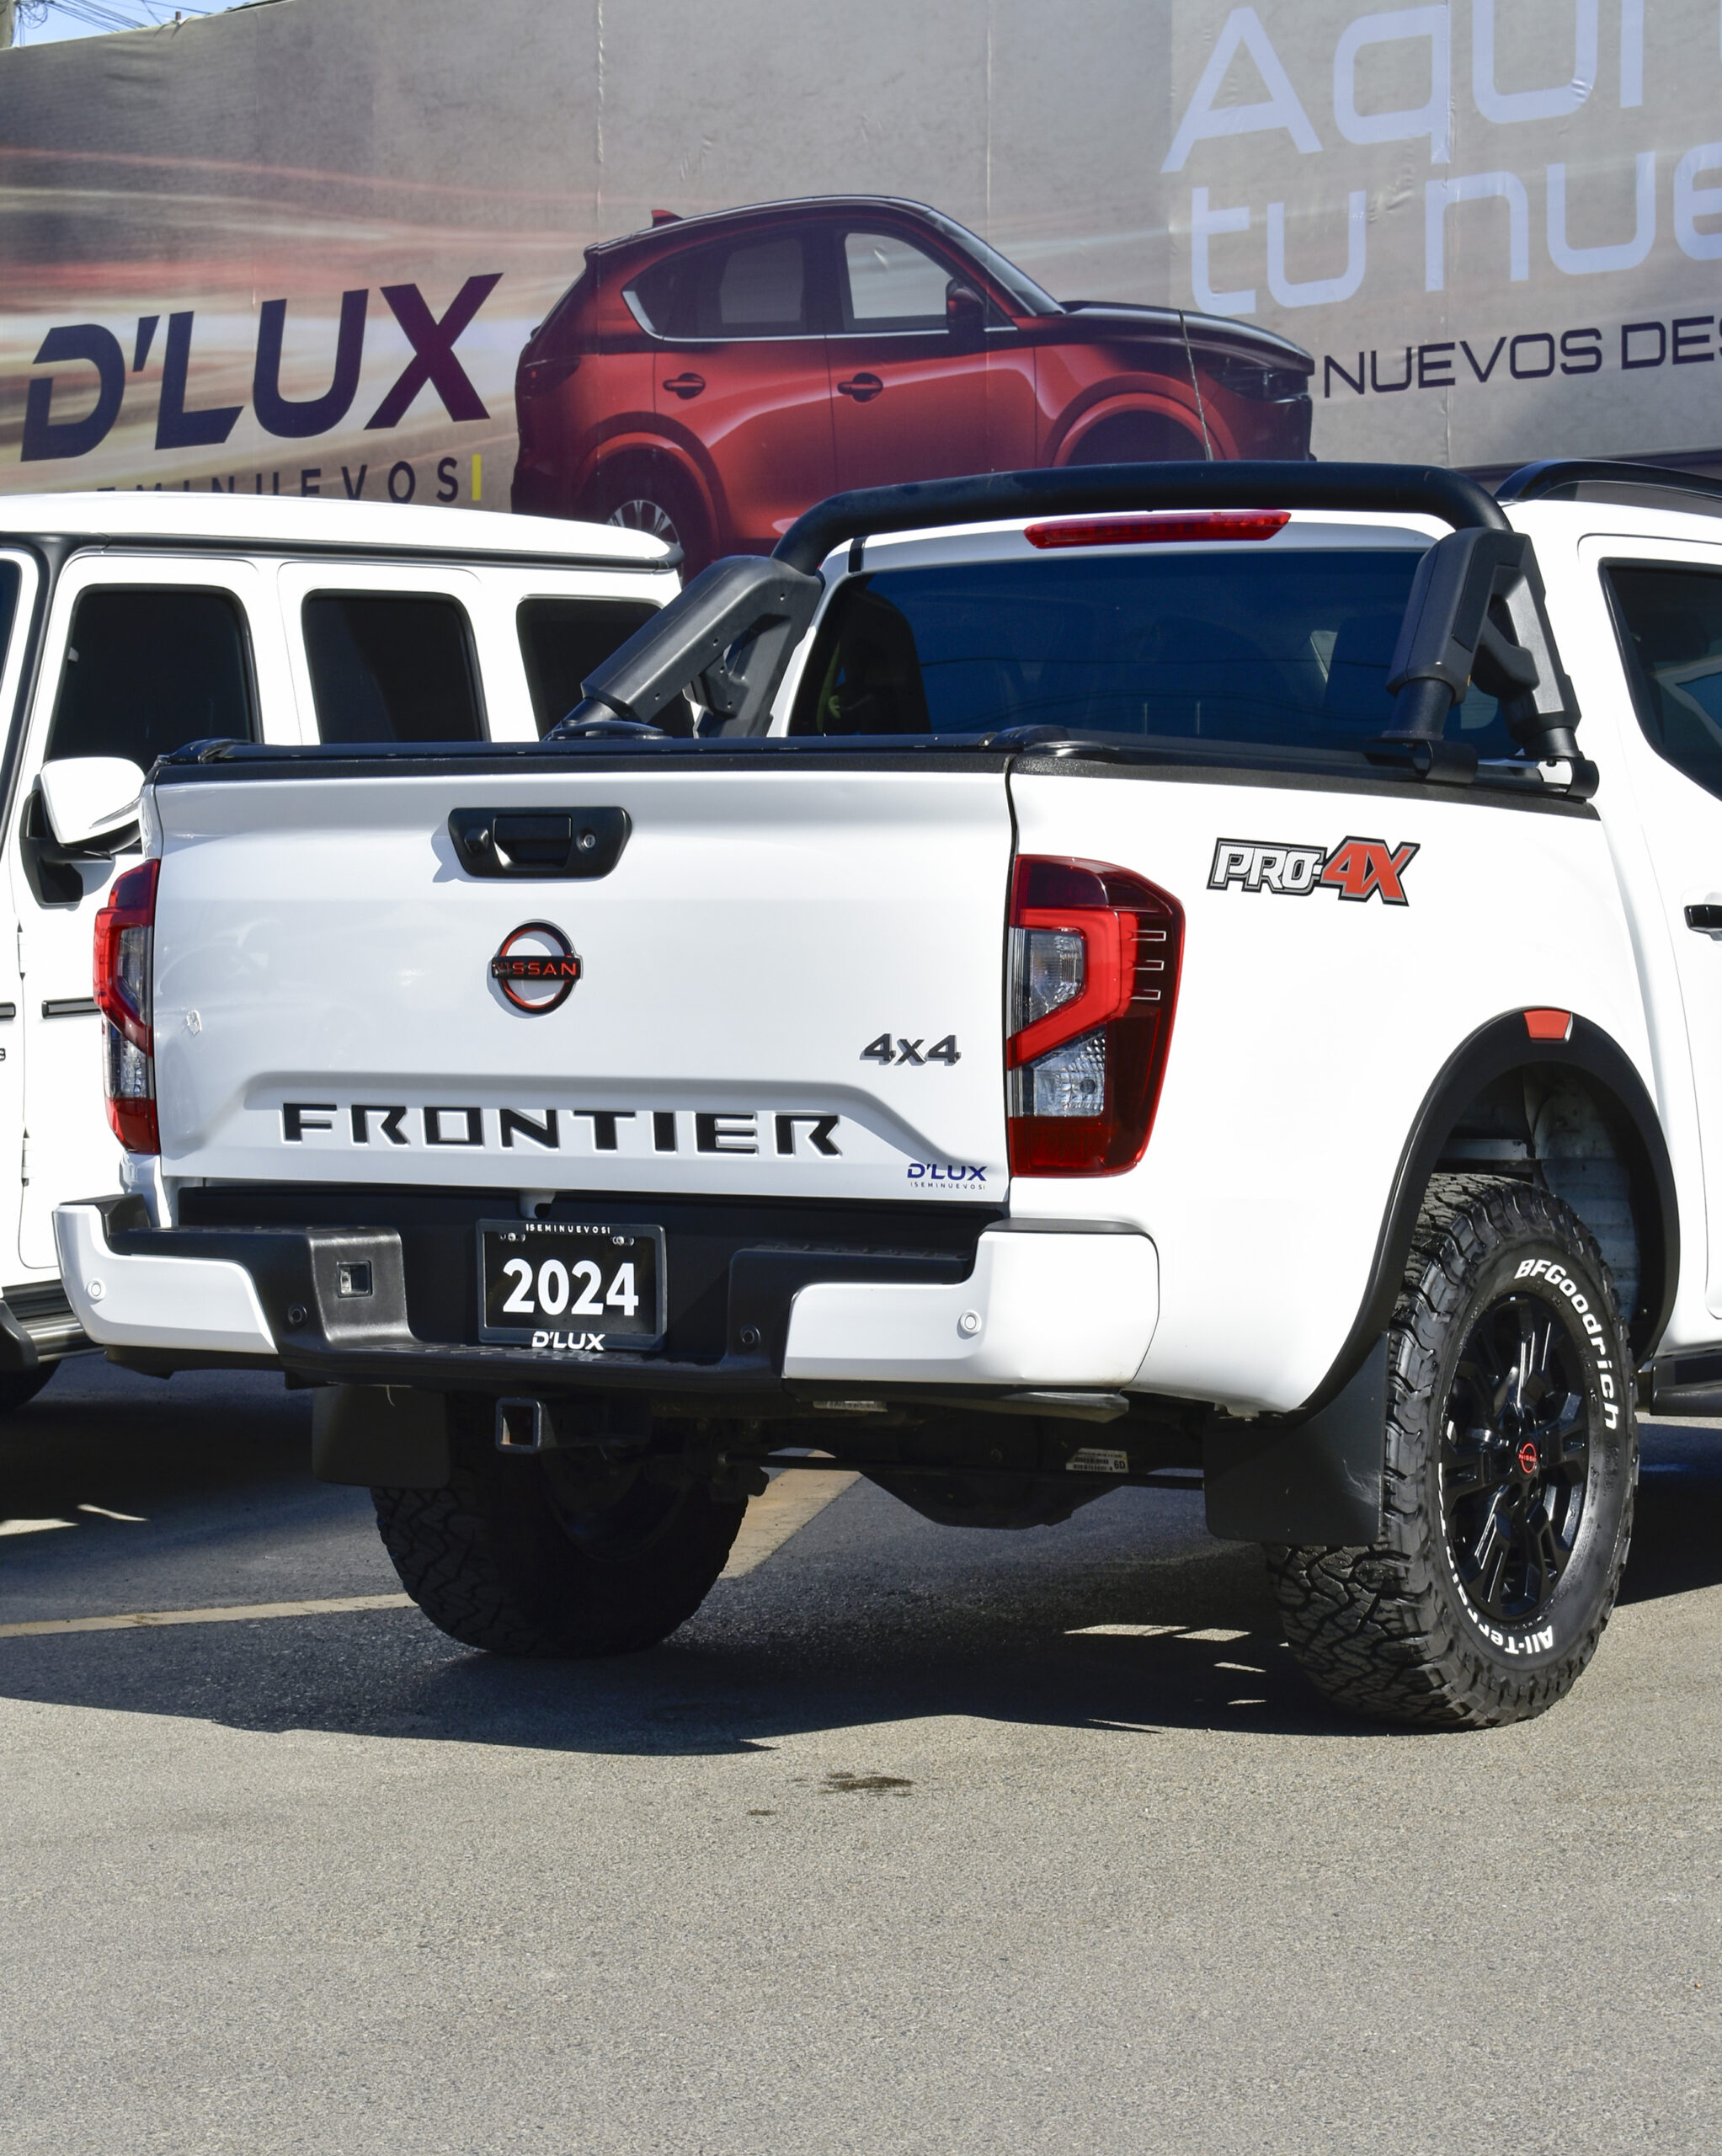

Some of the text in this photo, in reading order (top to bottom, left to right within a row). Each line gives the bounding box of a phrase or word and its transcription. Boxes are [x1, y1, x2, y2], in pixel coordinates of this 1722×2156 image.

[1191, 186, 1367, 316] tu
[20, 273, 504, 462] D'LUX
[1324, 316, 1722, 398] NUEVOS DE
[493, 961, 578, 976] NISSAN
[283, 1102, 840, 1156] FRONTIER
[907, 1163, 988, 1181] D'LUX
[503, 1258, 638, 1315] 2024
[531, 1331, 605, 1351] D'LUX
[1514, 1259, 1618, 1429] BFGoodrich
